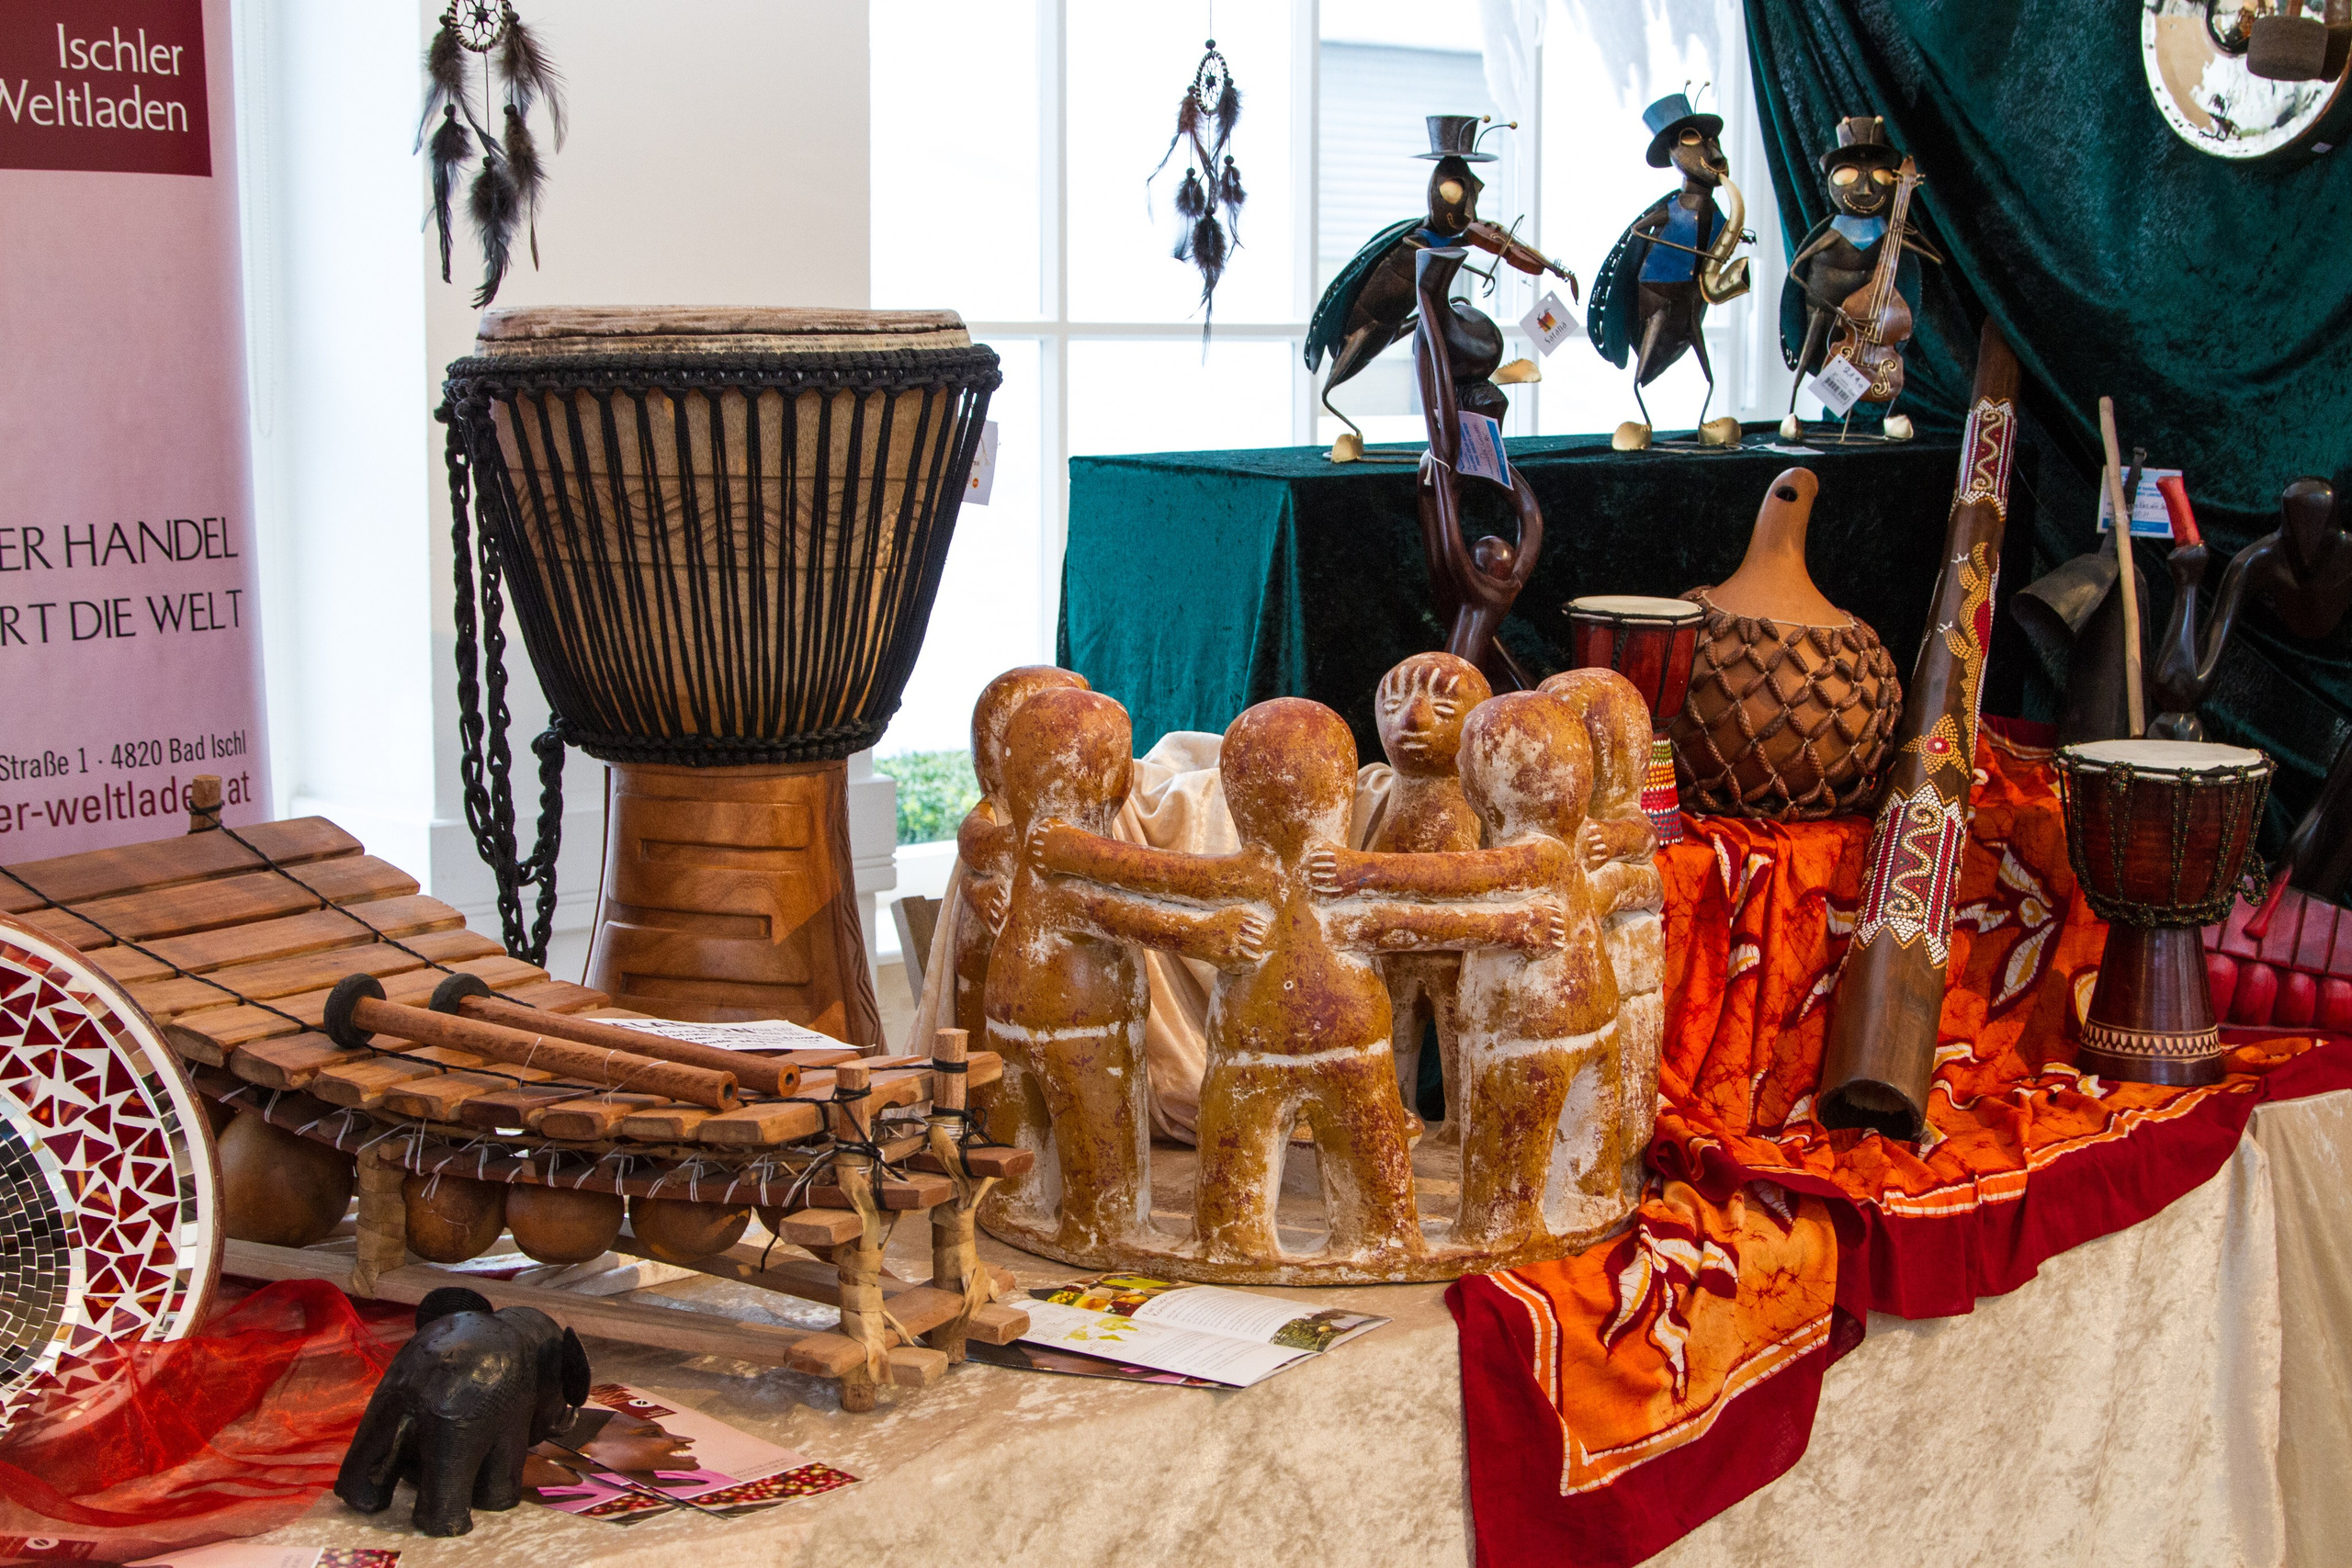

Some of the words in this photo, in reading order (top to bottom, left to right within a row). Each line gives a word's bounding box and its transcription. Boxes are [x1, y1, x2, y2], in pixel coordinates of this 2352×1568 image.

[56, 22, 184, 76] Ischler
[63, 516, 239, 568] HANDEL
[0, 603, 57, 647] RT
[69, 597, 137, 641] DIE
[145, 589, 243, 634] WELT
[0, 750, 70, 782] Straße
[77, 747, 89, 773] 1
[110, 739, 163, 770] 4820
[169, 734, 206, 763] Bad
[210, 729, 247, 758] Ischl
